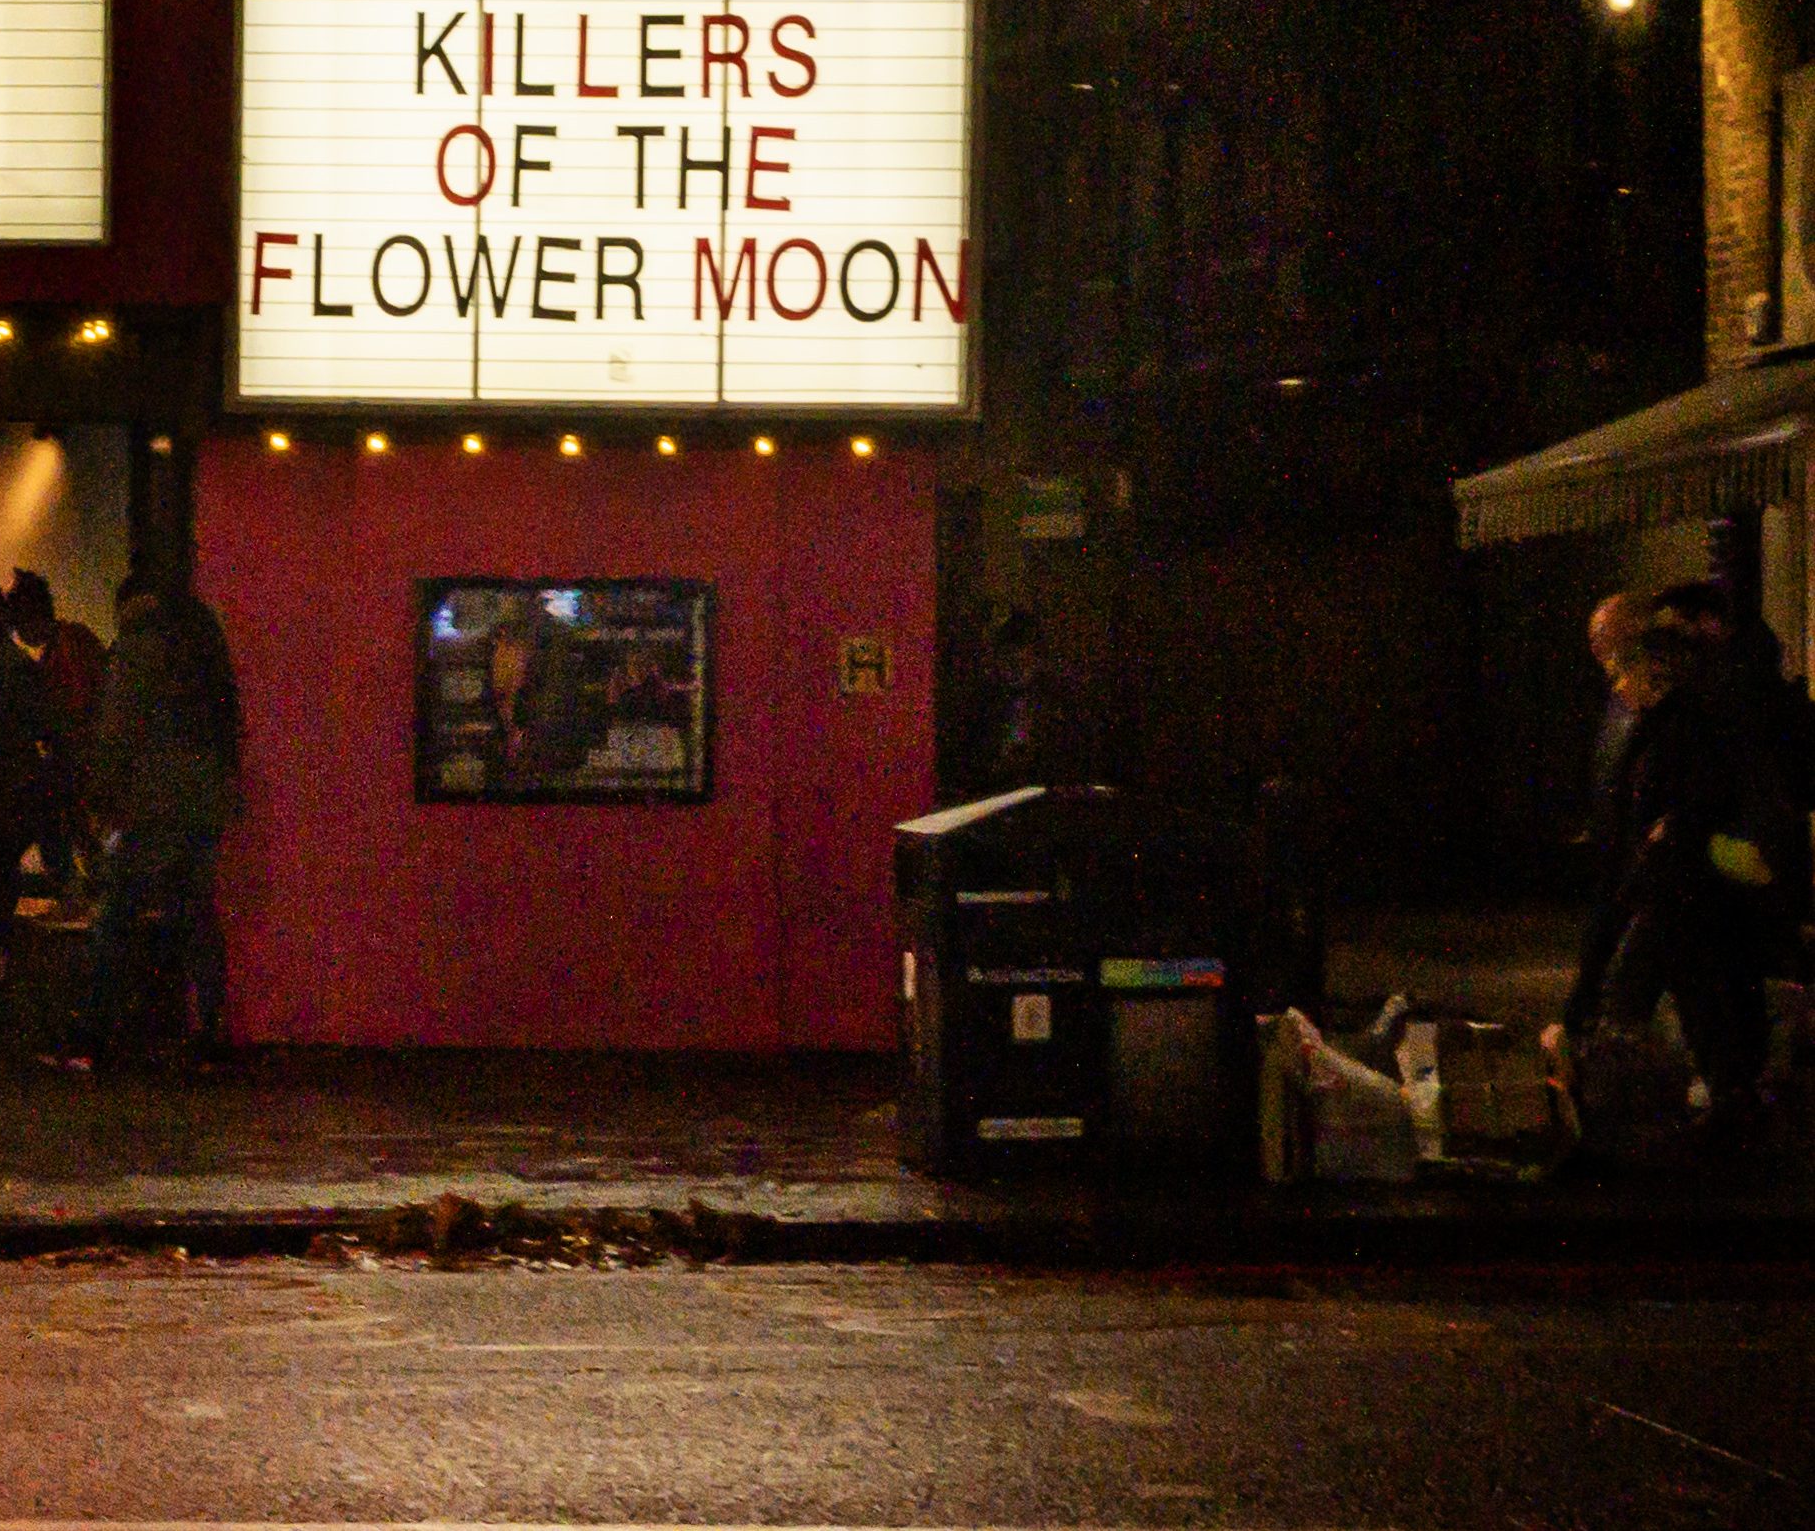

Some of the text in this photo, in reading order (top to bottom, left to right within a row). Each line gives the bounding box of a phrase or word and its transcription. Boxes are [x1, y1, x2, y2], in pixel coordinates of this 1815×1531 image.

[415, 11, 818, 99] KILLERS
[436, 123, 797, 212] OF THE
[250, 231, 970, 325] FLOWER MOON
